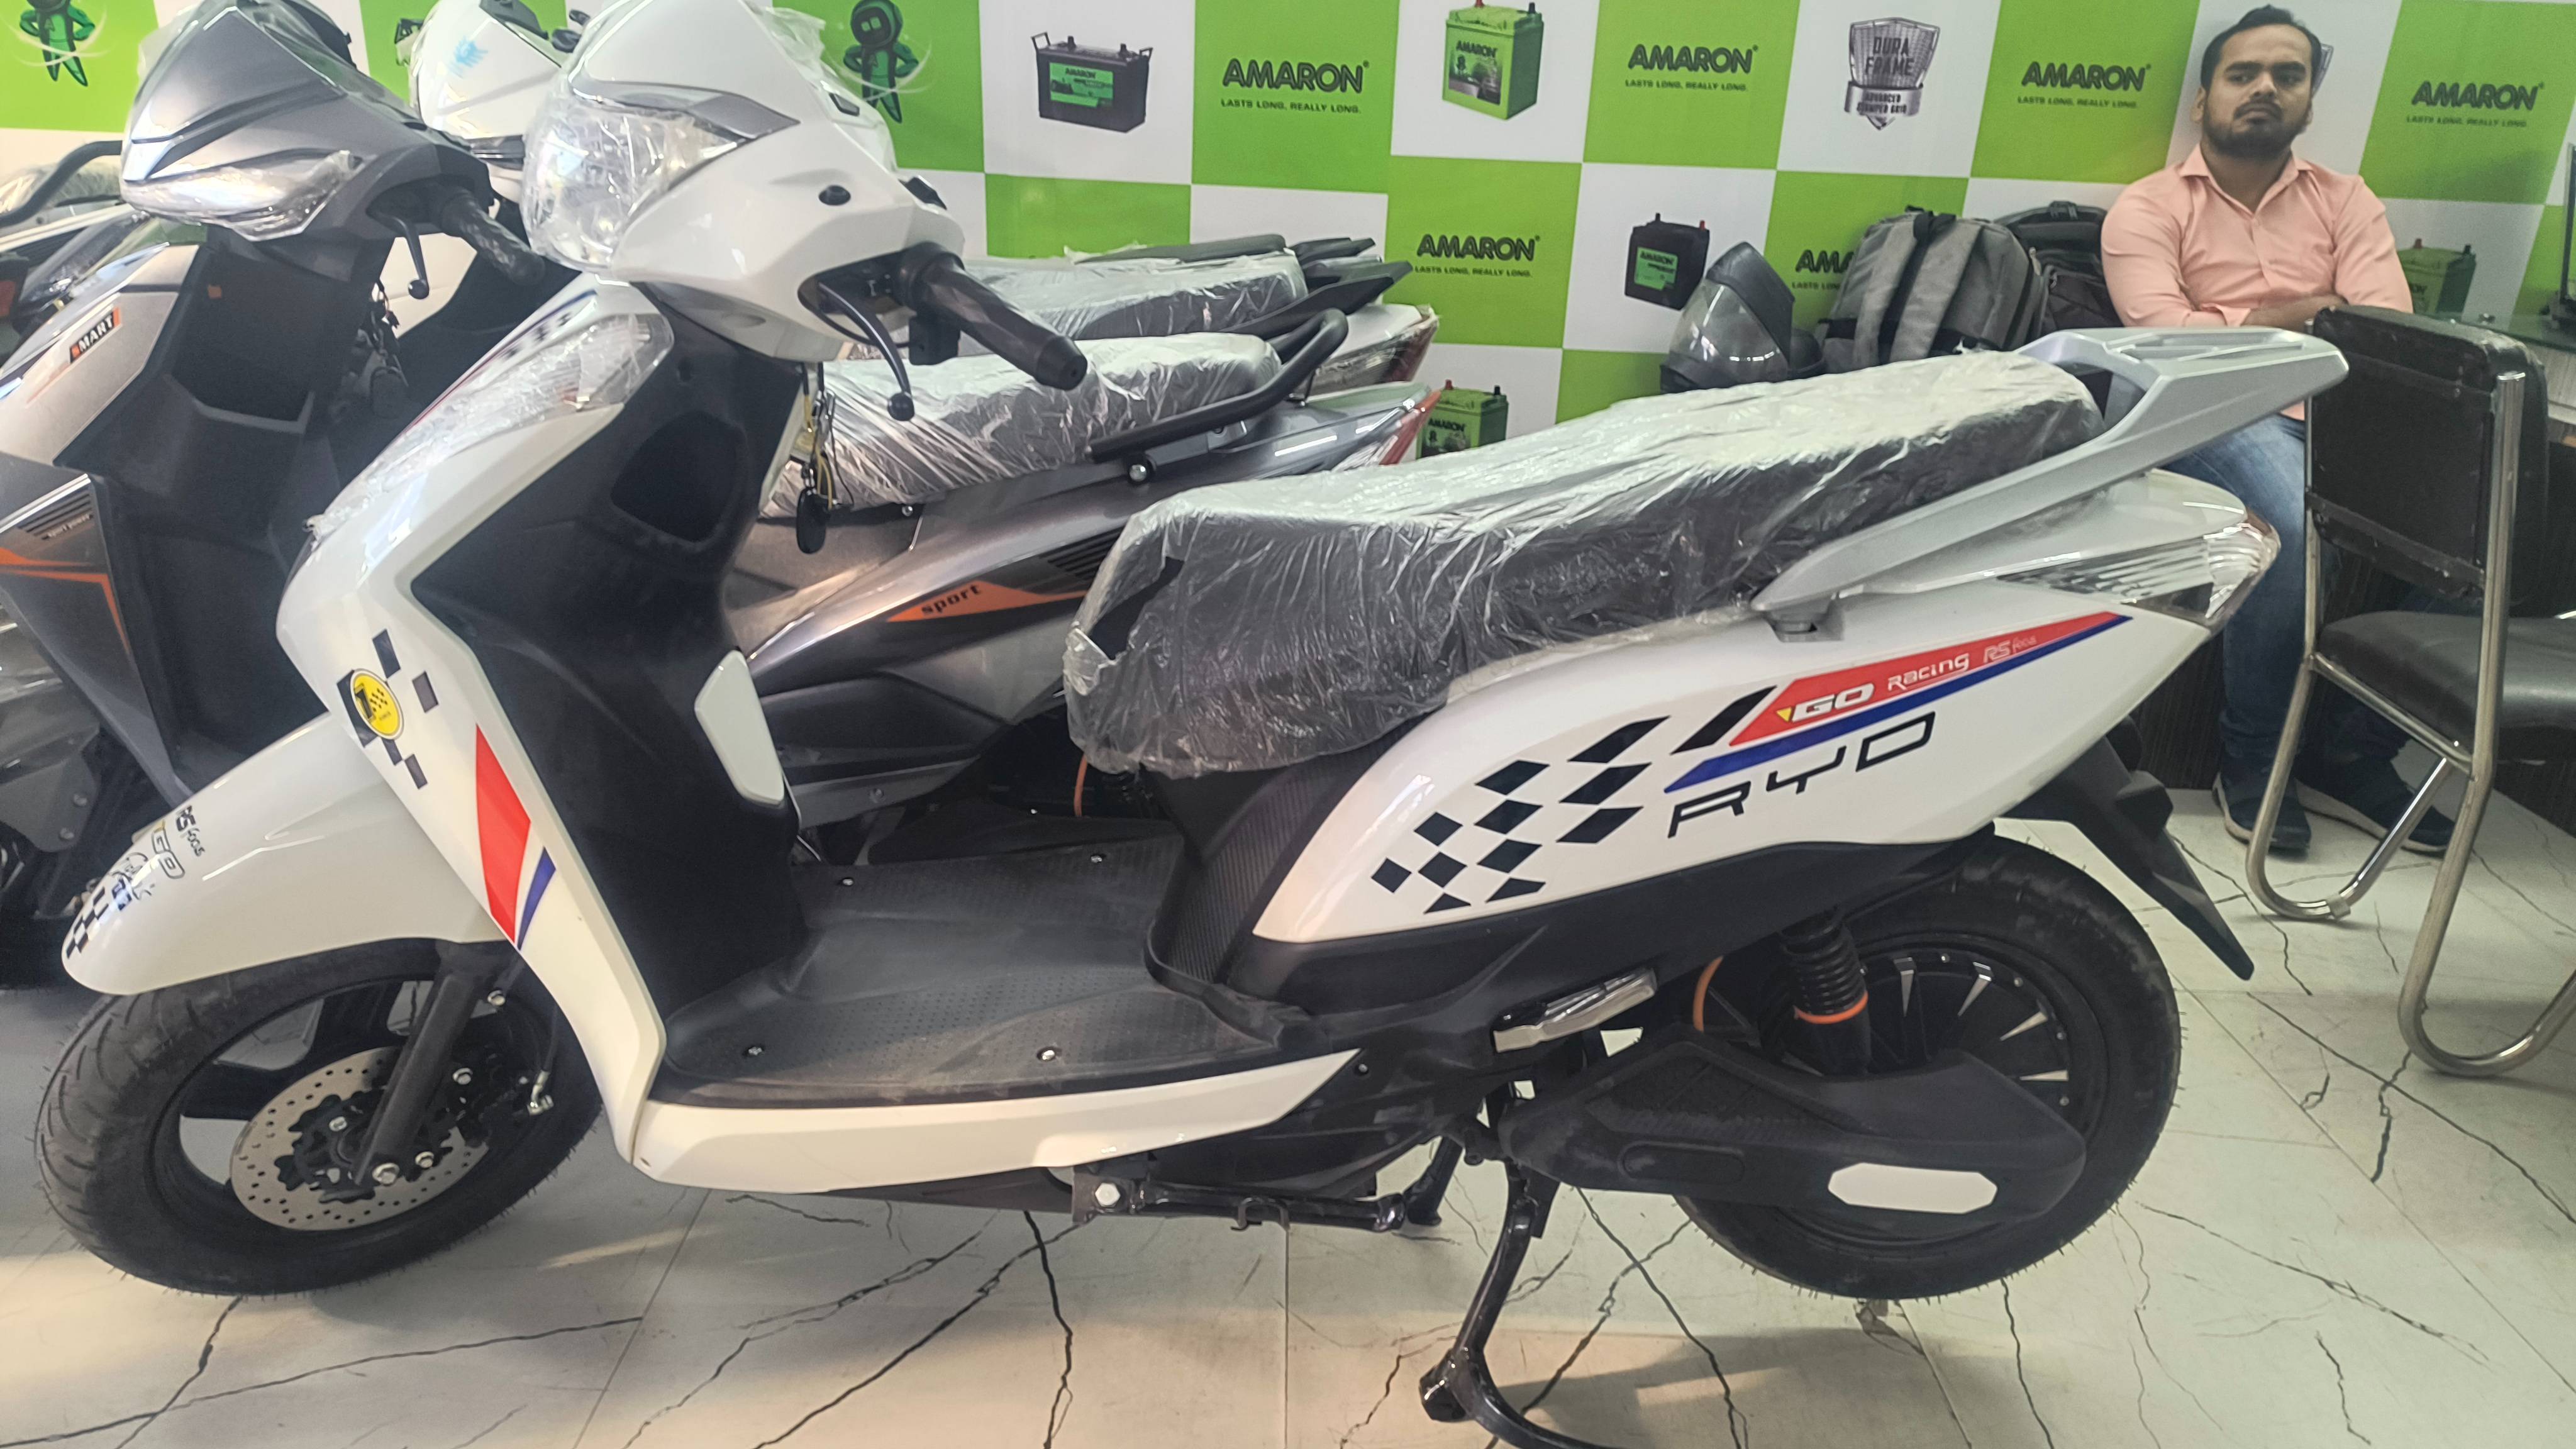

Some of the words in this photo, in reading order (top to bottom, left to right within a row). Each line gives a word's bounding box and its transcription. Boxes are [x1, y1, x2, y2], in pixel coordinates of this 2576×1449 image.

[1628, 43, 1753, 74] AMARON
[1873, 37, 1909, 55] DURA
[1223, 58, 1363, 94] AMARON
[1865, 57, 1914, 75] FRAME
[2021, 61, 2145, 91] AMARON
[1625, 79, 1653, 87] LASTS
[1685, 82, 1718, 90] REALLY
[2411, 80, 2539, 111] AMARON
[1221, 98, 1253, 108] LASTS
[1291, 103, 1326, 112] REALLY
[1417, 233, 1535, 261] AMARON
[921, 584, 981, 613] sport
[1887, 653, 1969, 691] Racing
[1983, 640, 2011, 663] RS
